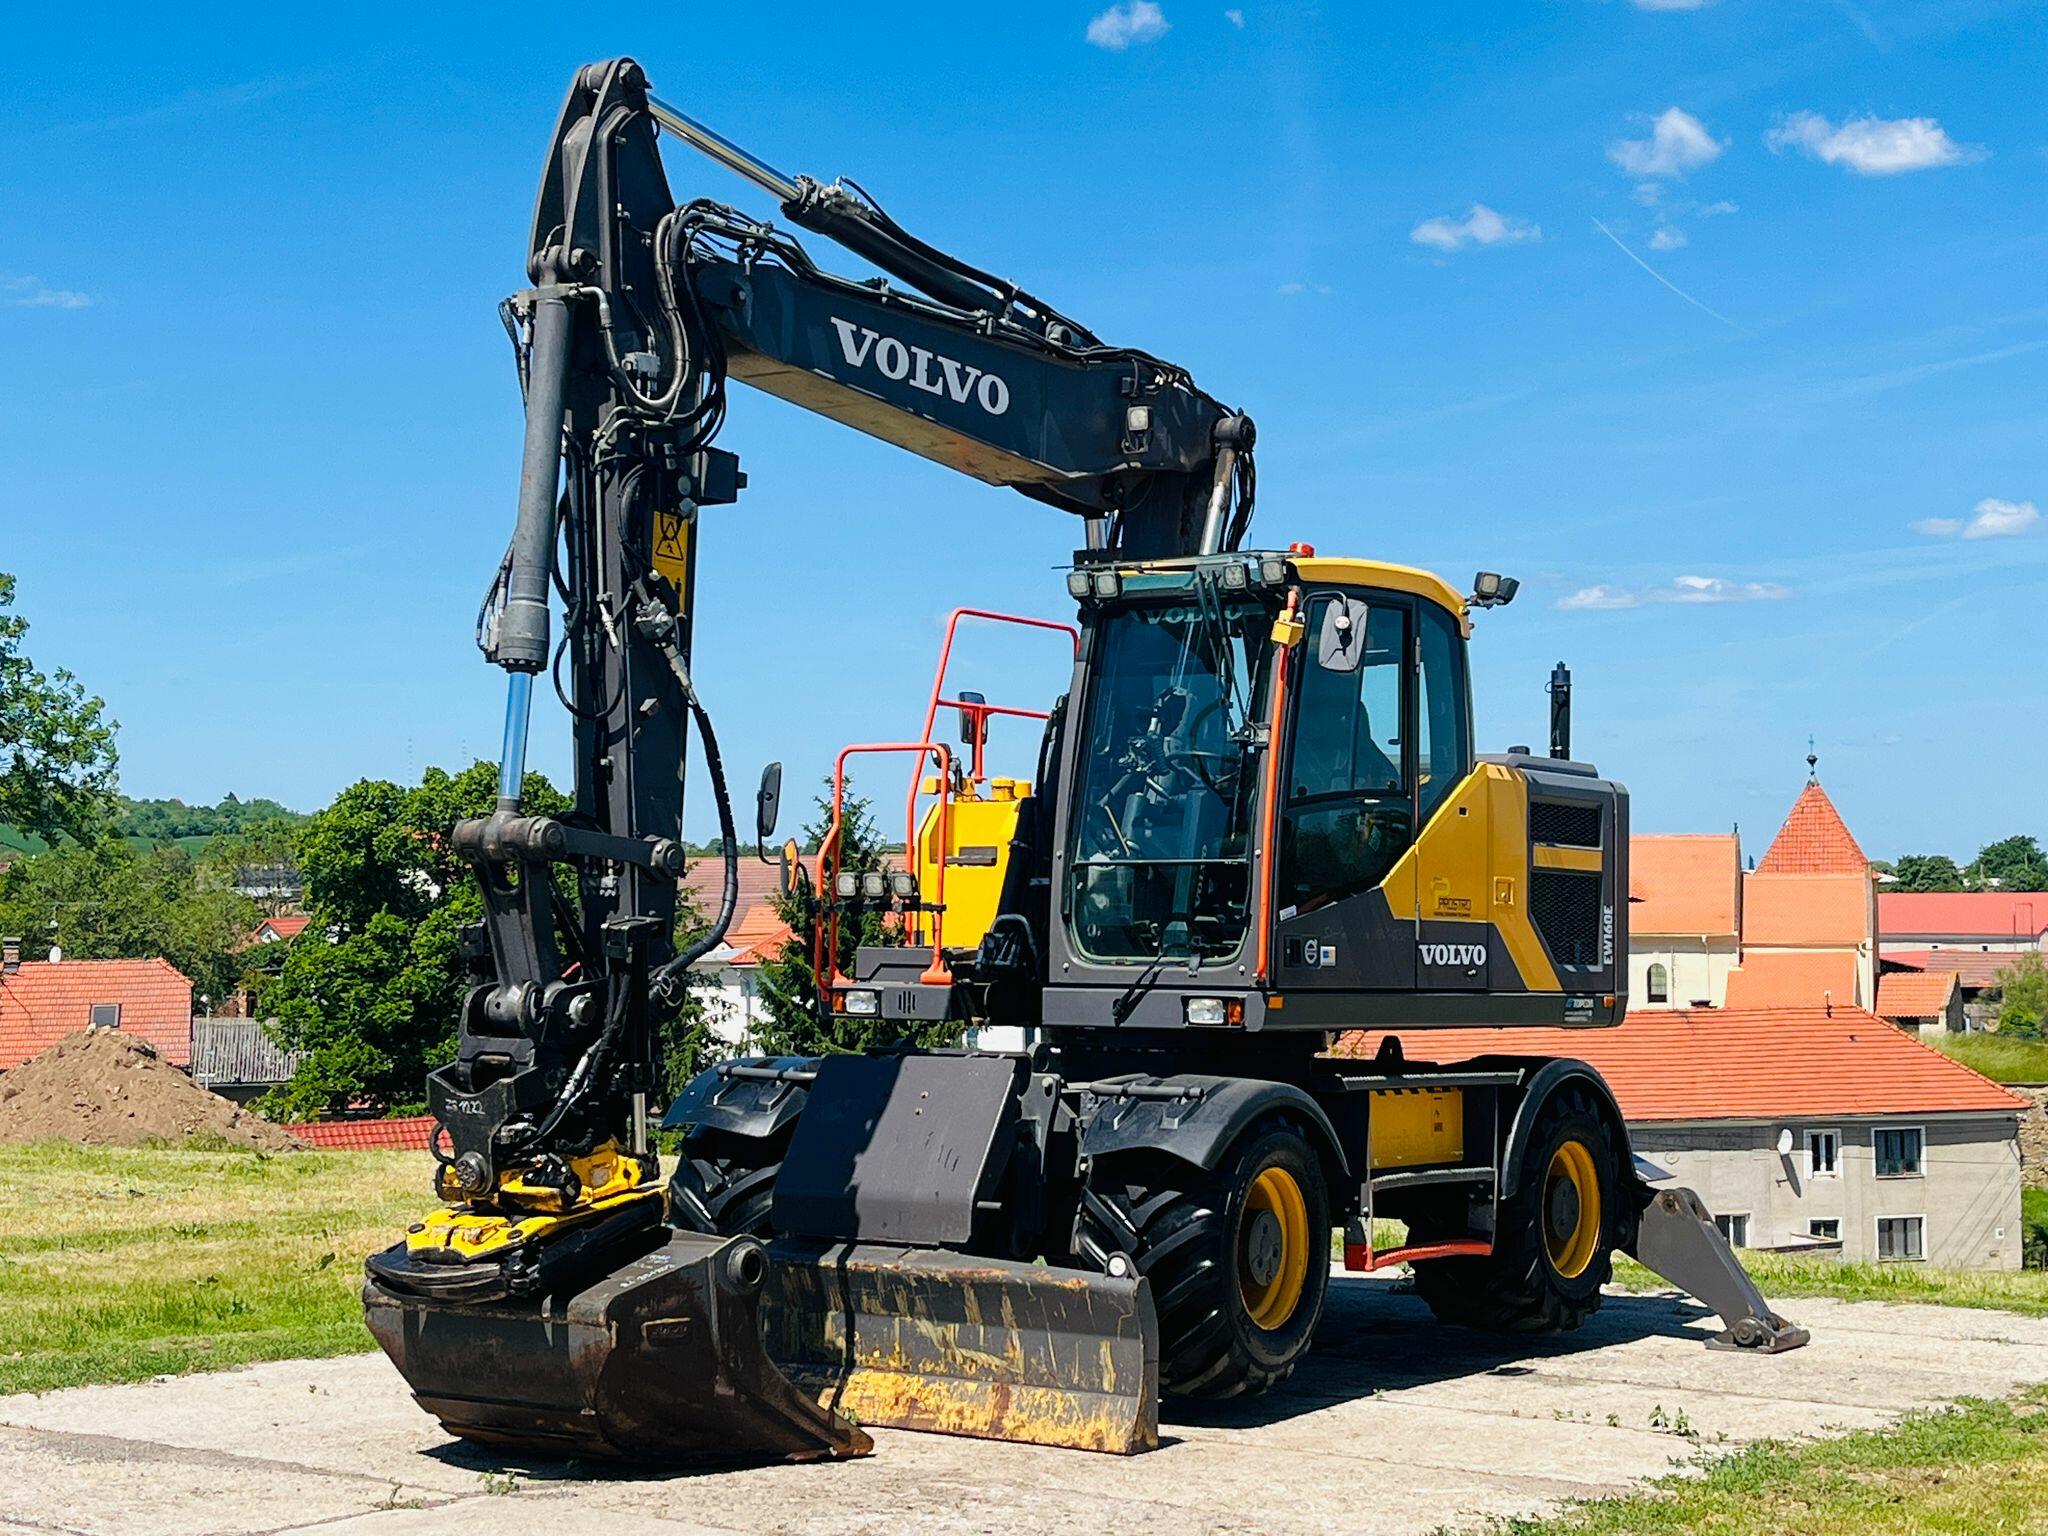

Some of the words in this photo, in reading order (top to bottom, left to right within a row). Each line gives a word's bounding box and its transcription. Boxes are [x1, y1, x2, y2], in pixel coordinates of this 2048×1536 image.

[830, 316, 1010, 415] VOLVO
[1418, 944, 1487, 966] VOLVO
[1603, 904, 1613, 965] EW160E
